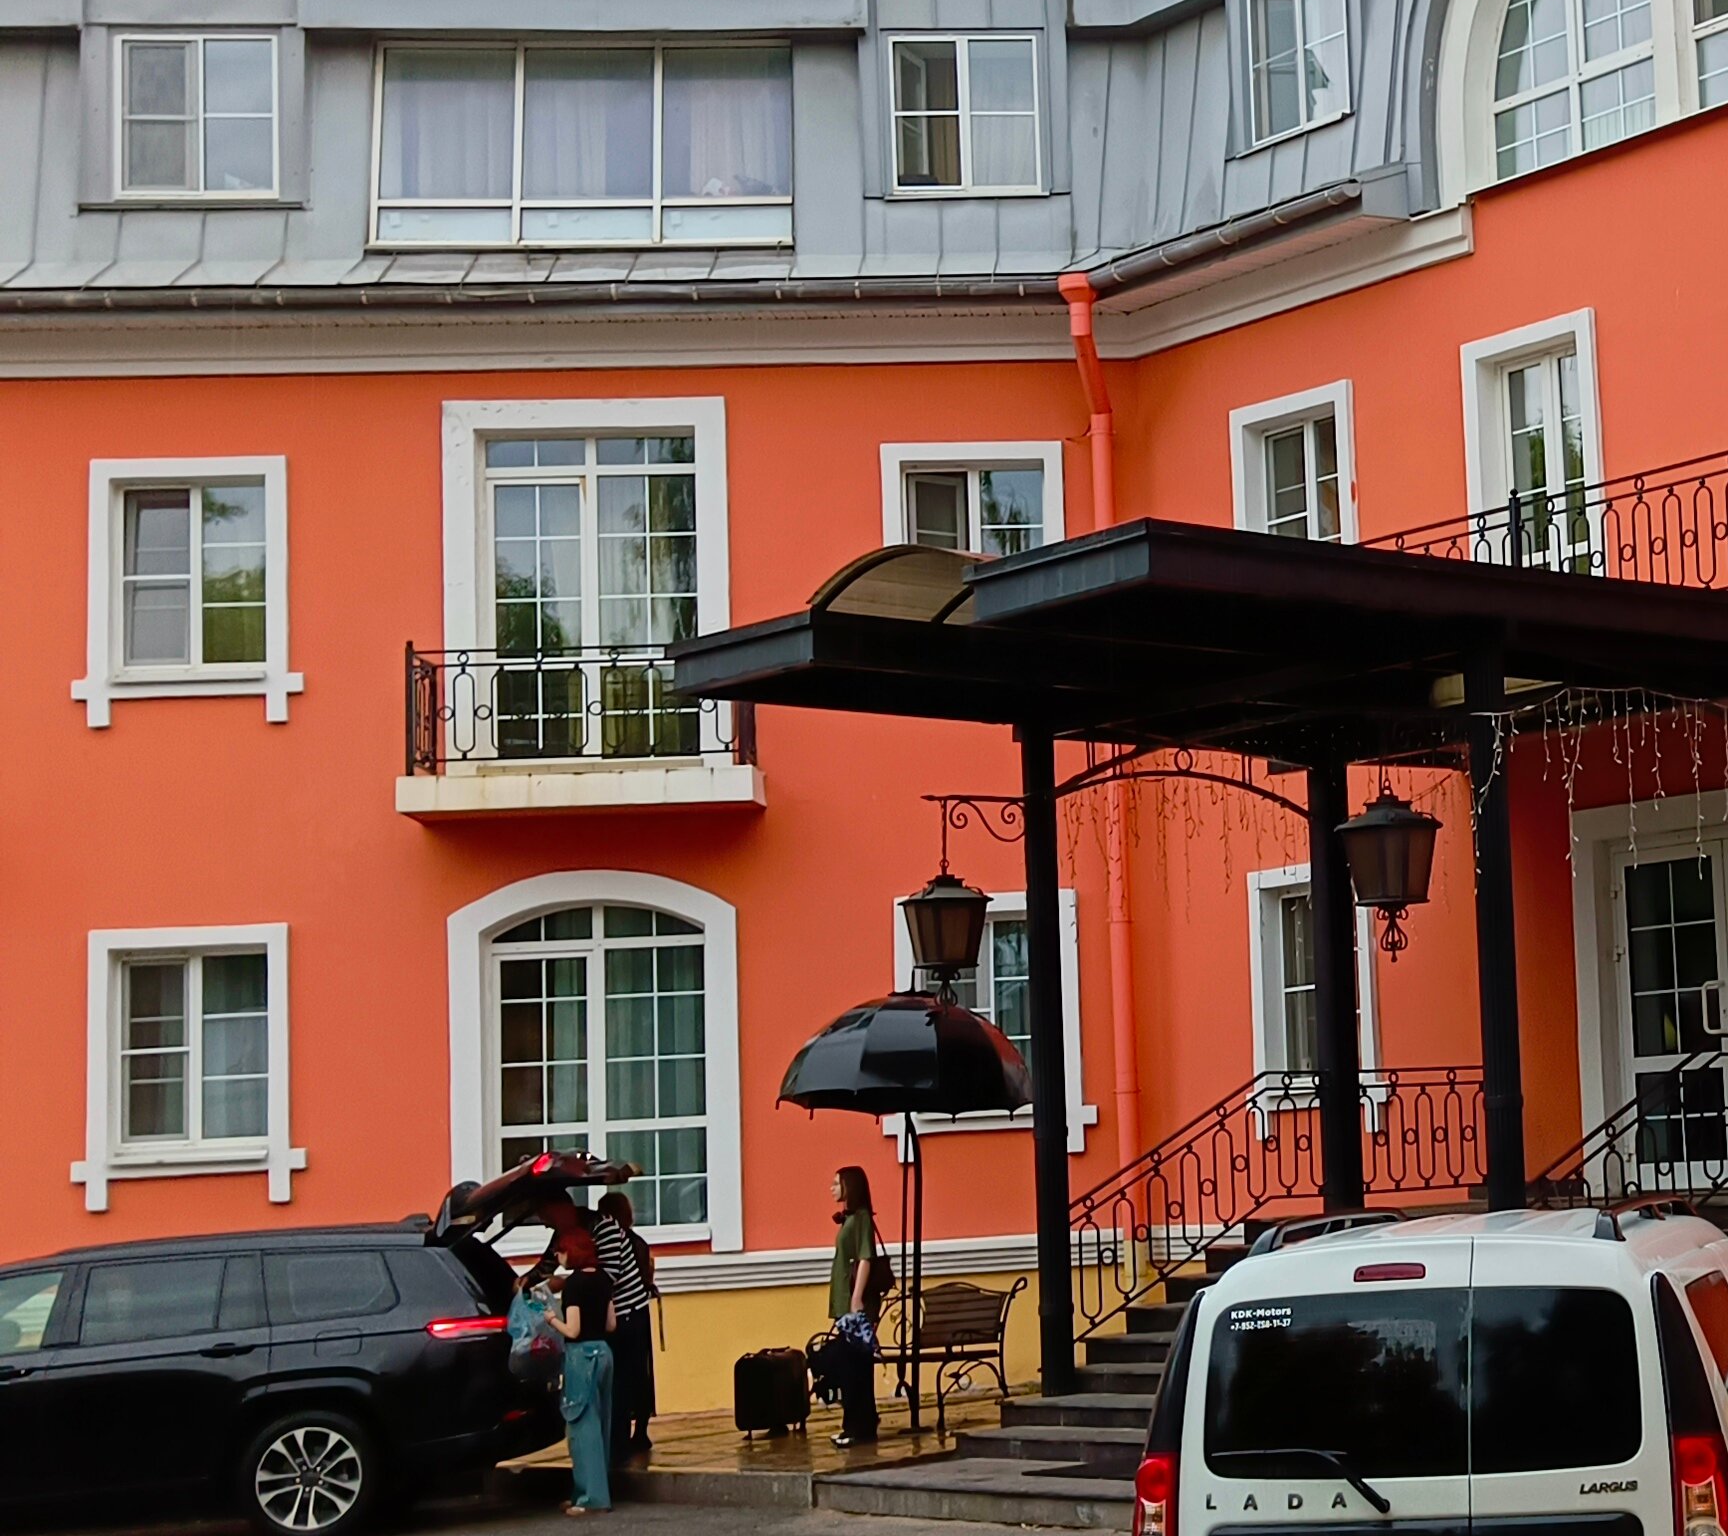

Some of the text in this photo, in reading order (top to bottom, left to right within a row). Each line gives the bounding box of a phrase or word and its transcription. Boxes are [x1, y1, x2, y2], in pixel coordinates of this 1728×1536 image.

[1230, 1308, 1292, 1320] KDK-Motors
[1579, 1480, 1638, 1495] LARGUS
[1206, 1492, 1347, 1511] LADA
